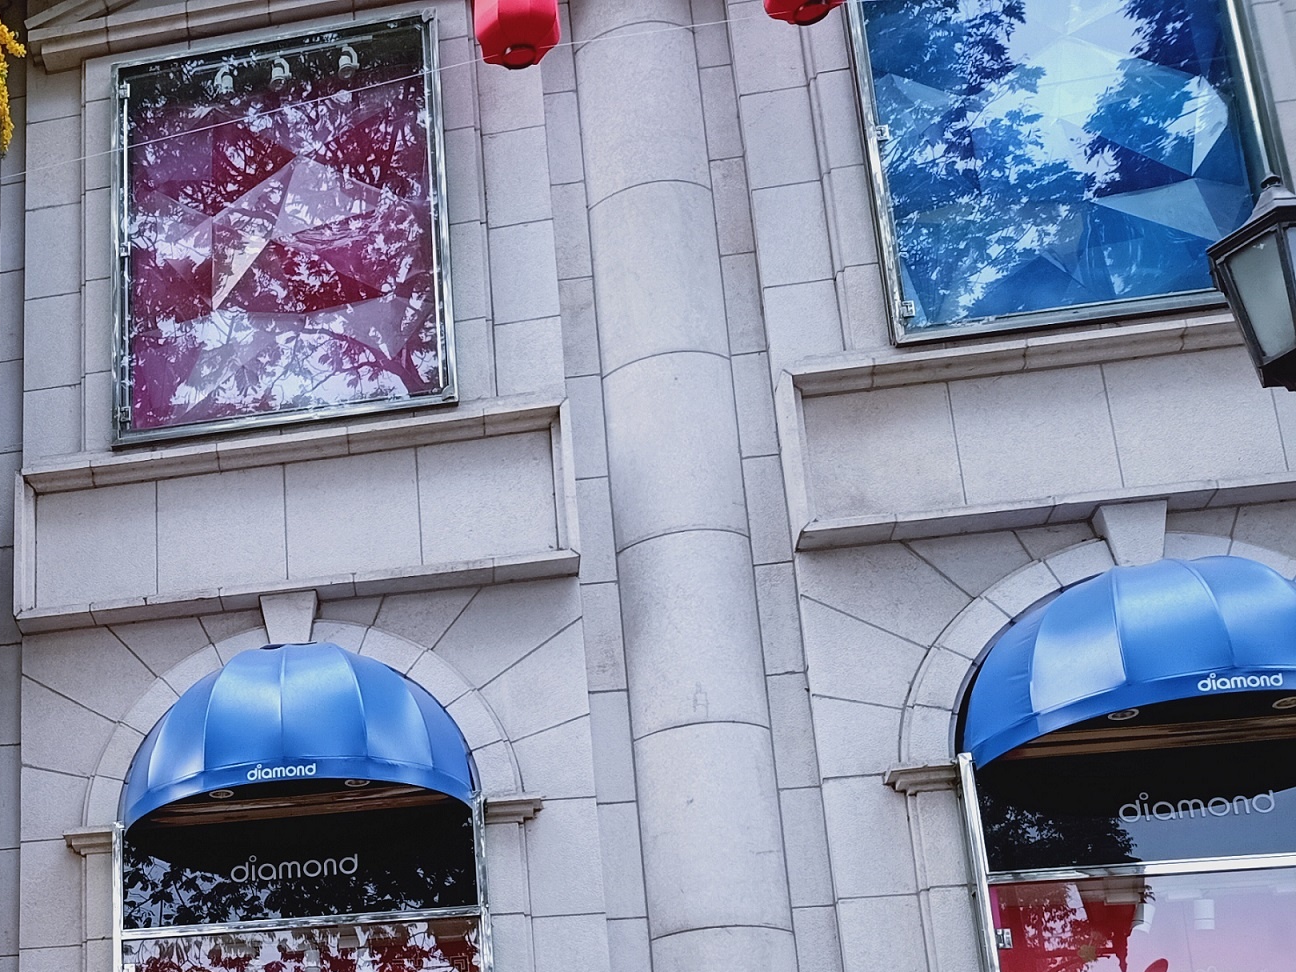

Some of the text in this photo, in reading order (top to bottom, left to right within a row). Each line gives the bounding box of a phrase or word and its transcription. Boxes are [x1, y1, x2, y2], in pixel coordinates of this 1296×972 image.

[1197, 672, 1284, 692] diamond
[247, 763, 317, 781] diamond
[1119, 789, 1276, 823] diamond
[230, 853, 359, 883] diamond
